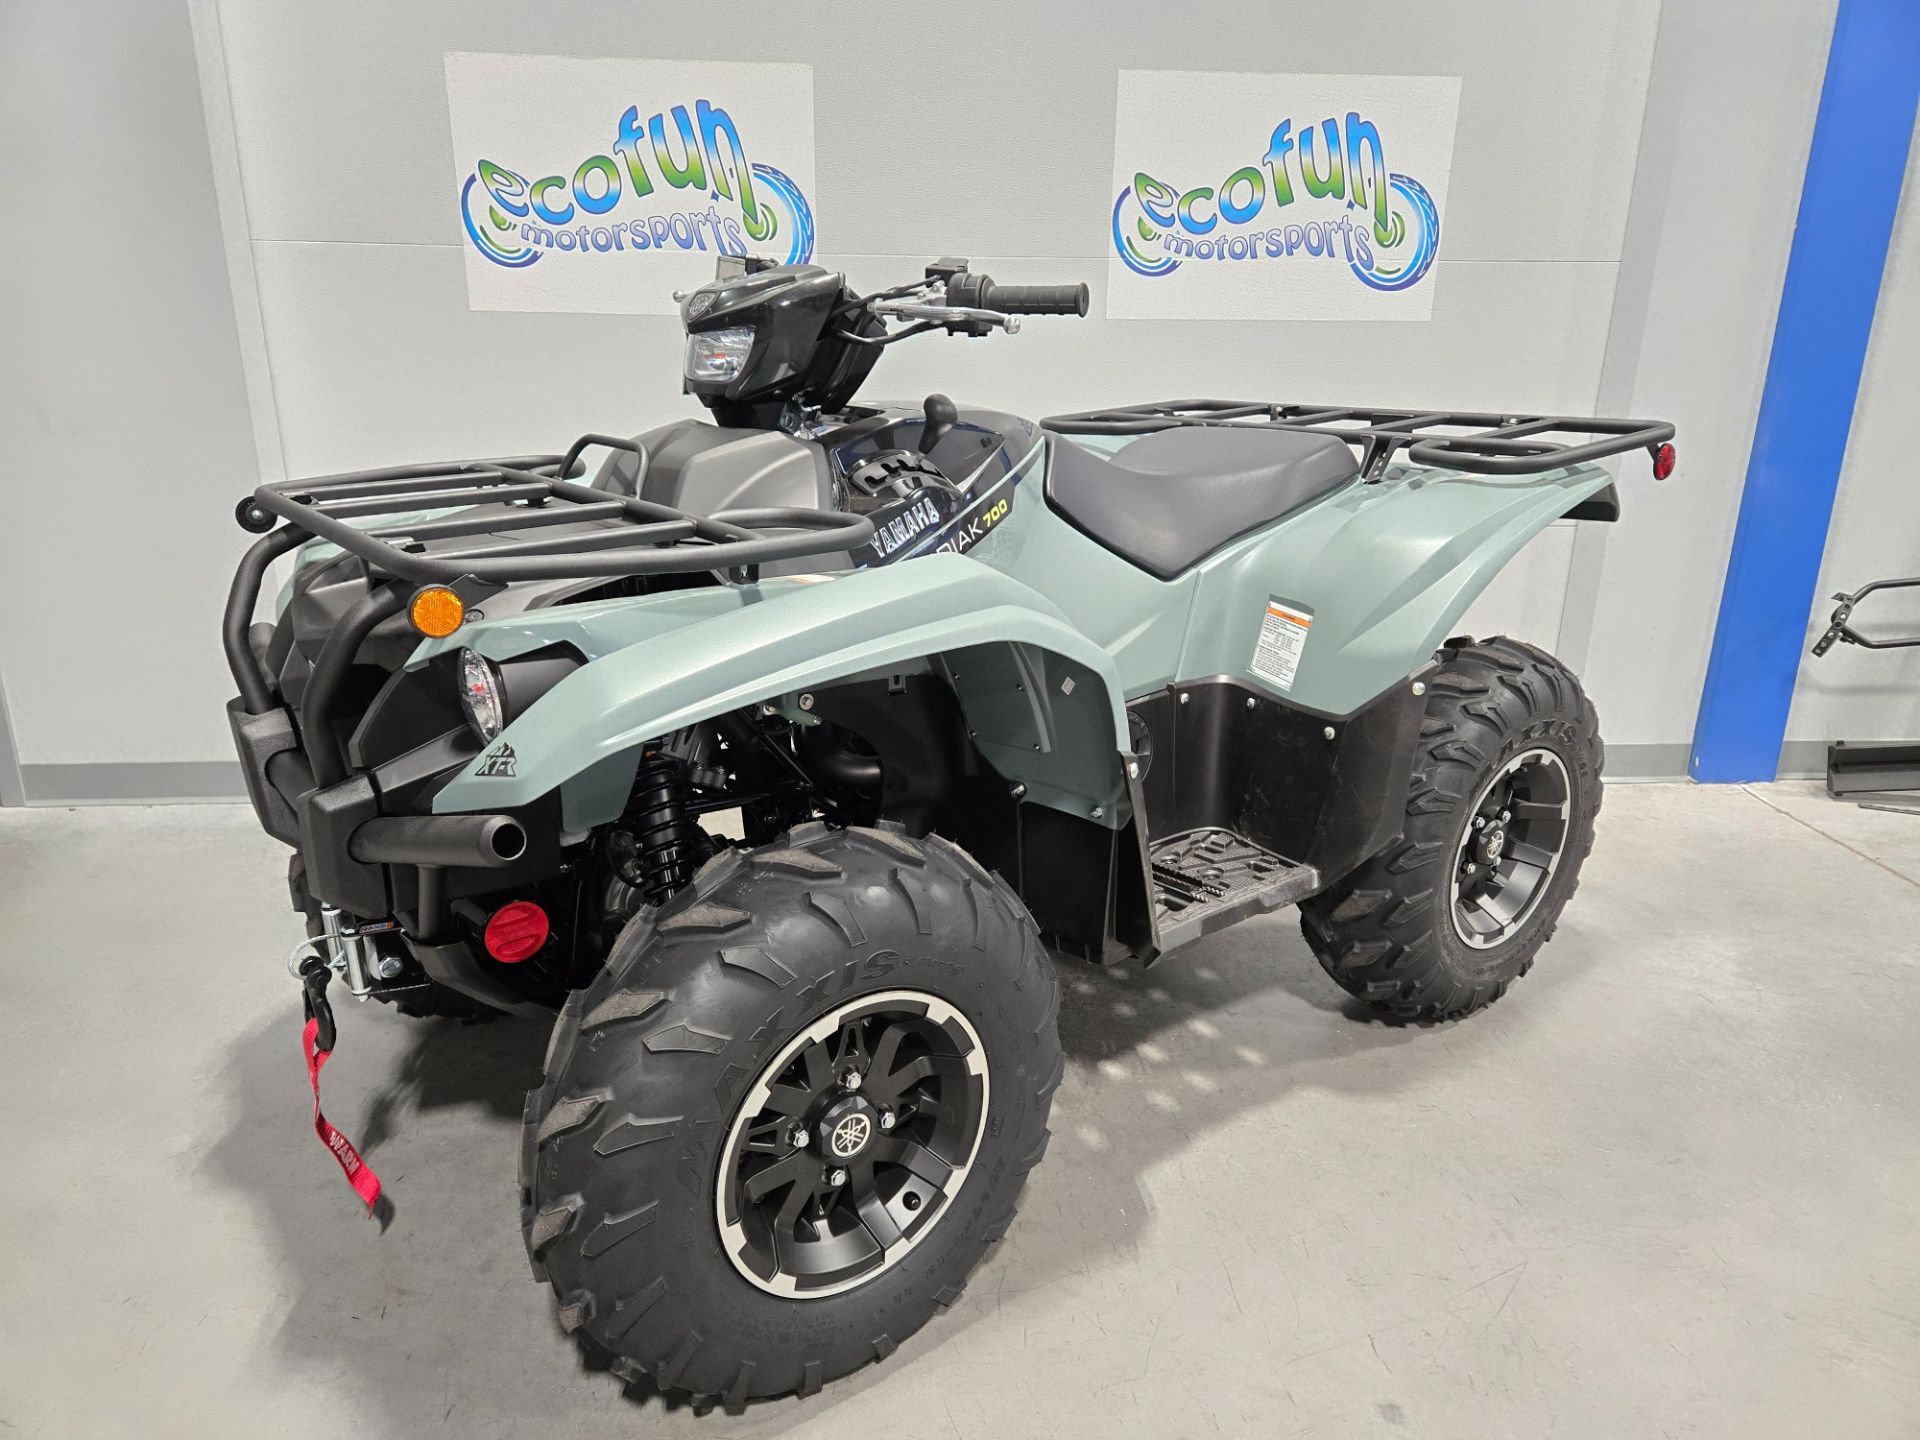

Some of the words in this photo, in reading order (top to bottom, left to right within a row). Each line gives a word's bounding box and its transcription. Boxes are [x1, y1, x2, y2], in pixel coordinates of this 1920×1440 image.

[520, 206, 748, 258] motorsports
[1163, 215, 1375, 271] motorsports
[870, 497, 940, 559] YAMAHA
[983, 498, 1008, 528] 700
